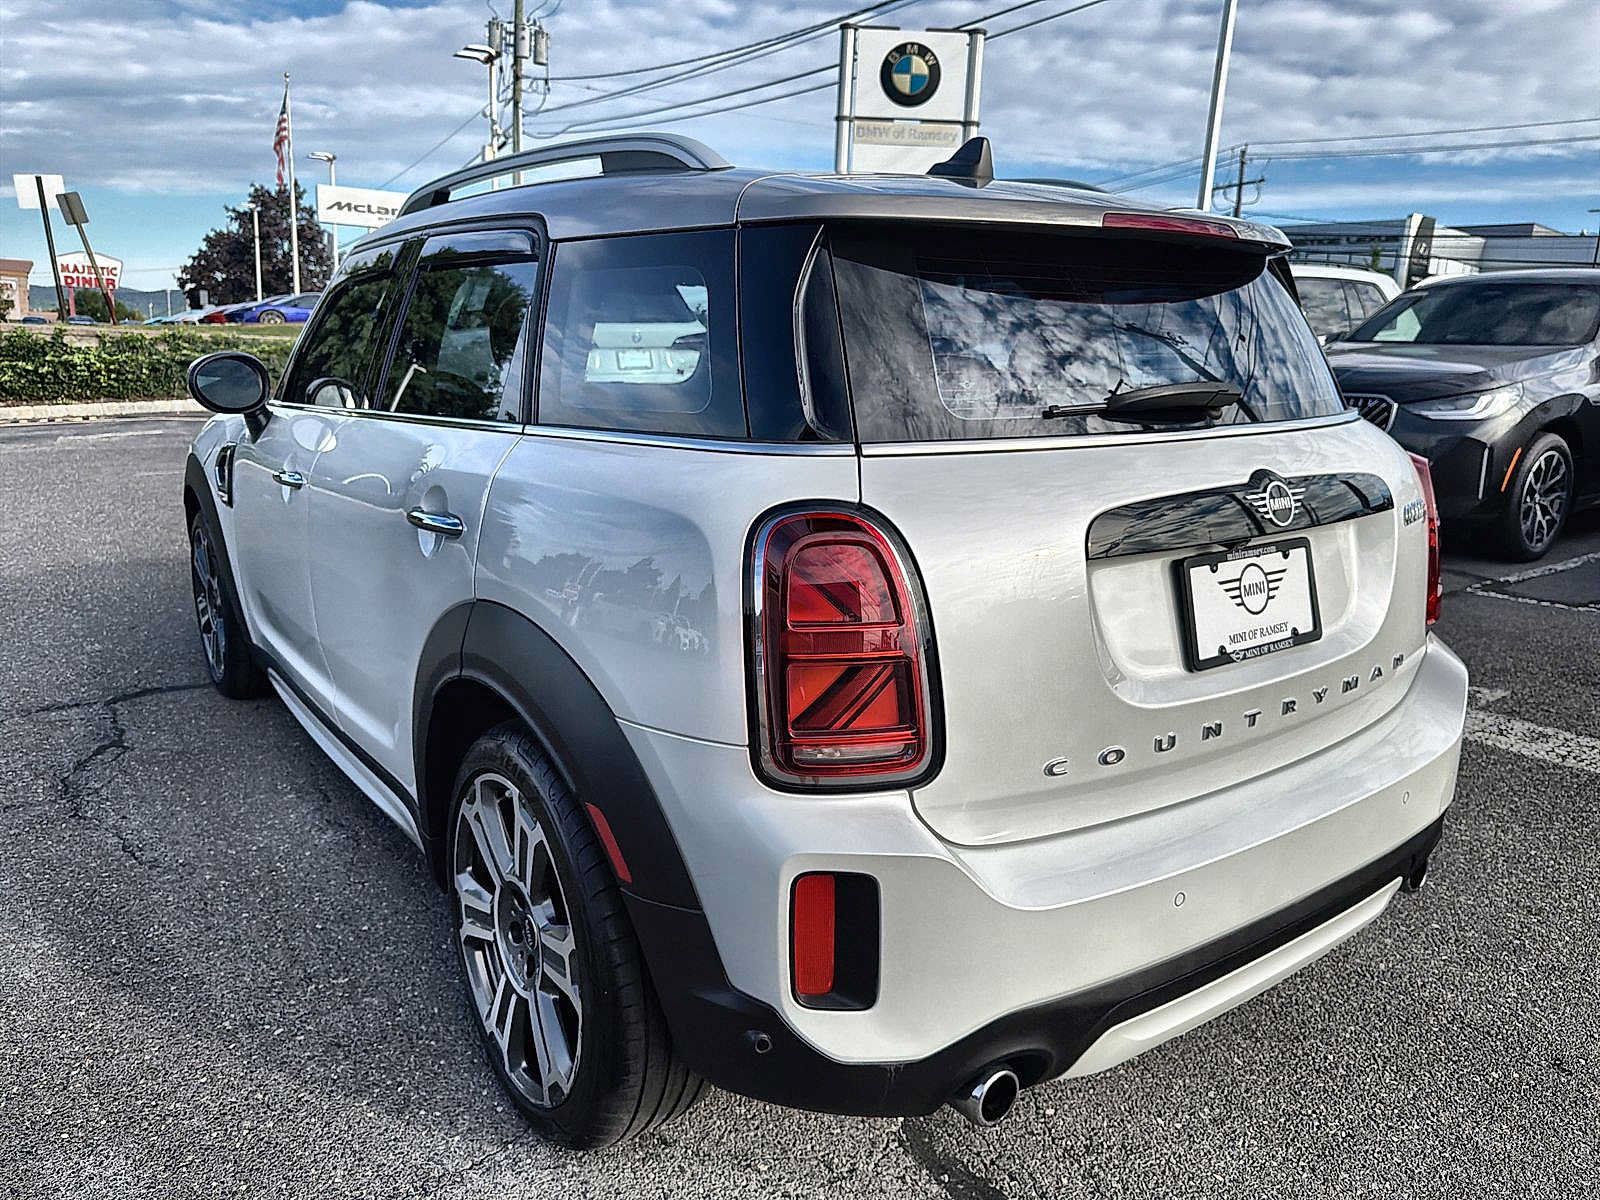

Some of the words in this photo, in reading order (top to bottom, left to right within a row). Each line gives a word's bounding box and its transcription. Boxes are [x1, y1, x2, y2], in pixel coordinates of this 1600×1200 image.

[888, 44, 936, 65] BMW
[856, 126, 889, 137] BMW
[892, 127, 906, 140] of
[910, 128, 958, 143] Ramsey
[326, 201, 399, 216] McLar
[61, 263, 117, 276] MAJETIC
[1270, 497, 1291, 510] MINI
[1227, 546, 1276, 560] miniramsey.com
[1243, 580, 1266, 598] MINI
[1228, 632, 1247, 645] MINI
[1249, 629, 1258, 640] OF
[1258, 621, 1289, 639] RAMSEY
[1245, 649, 1261, 659] MINI
[1260, 646, 1269, 655] OF
[1269, 639, 1294, 653] RAMSEY
[1043, 652, 1404, 778] COUNTRYMAN
